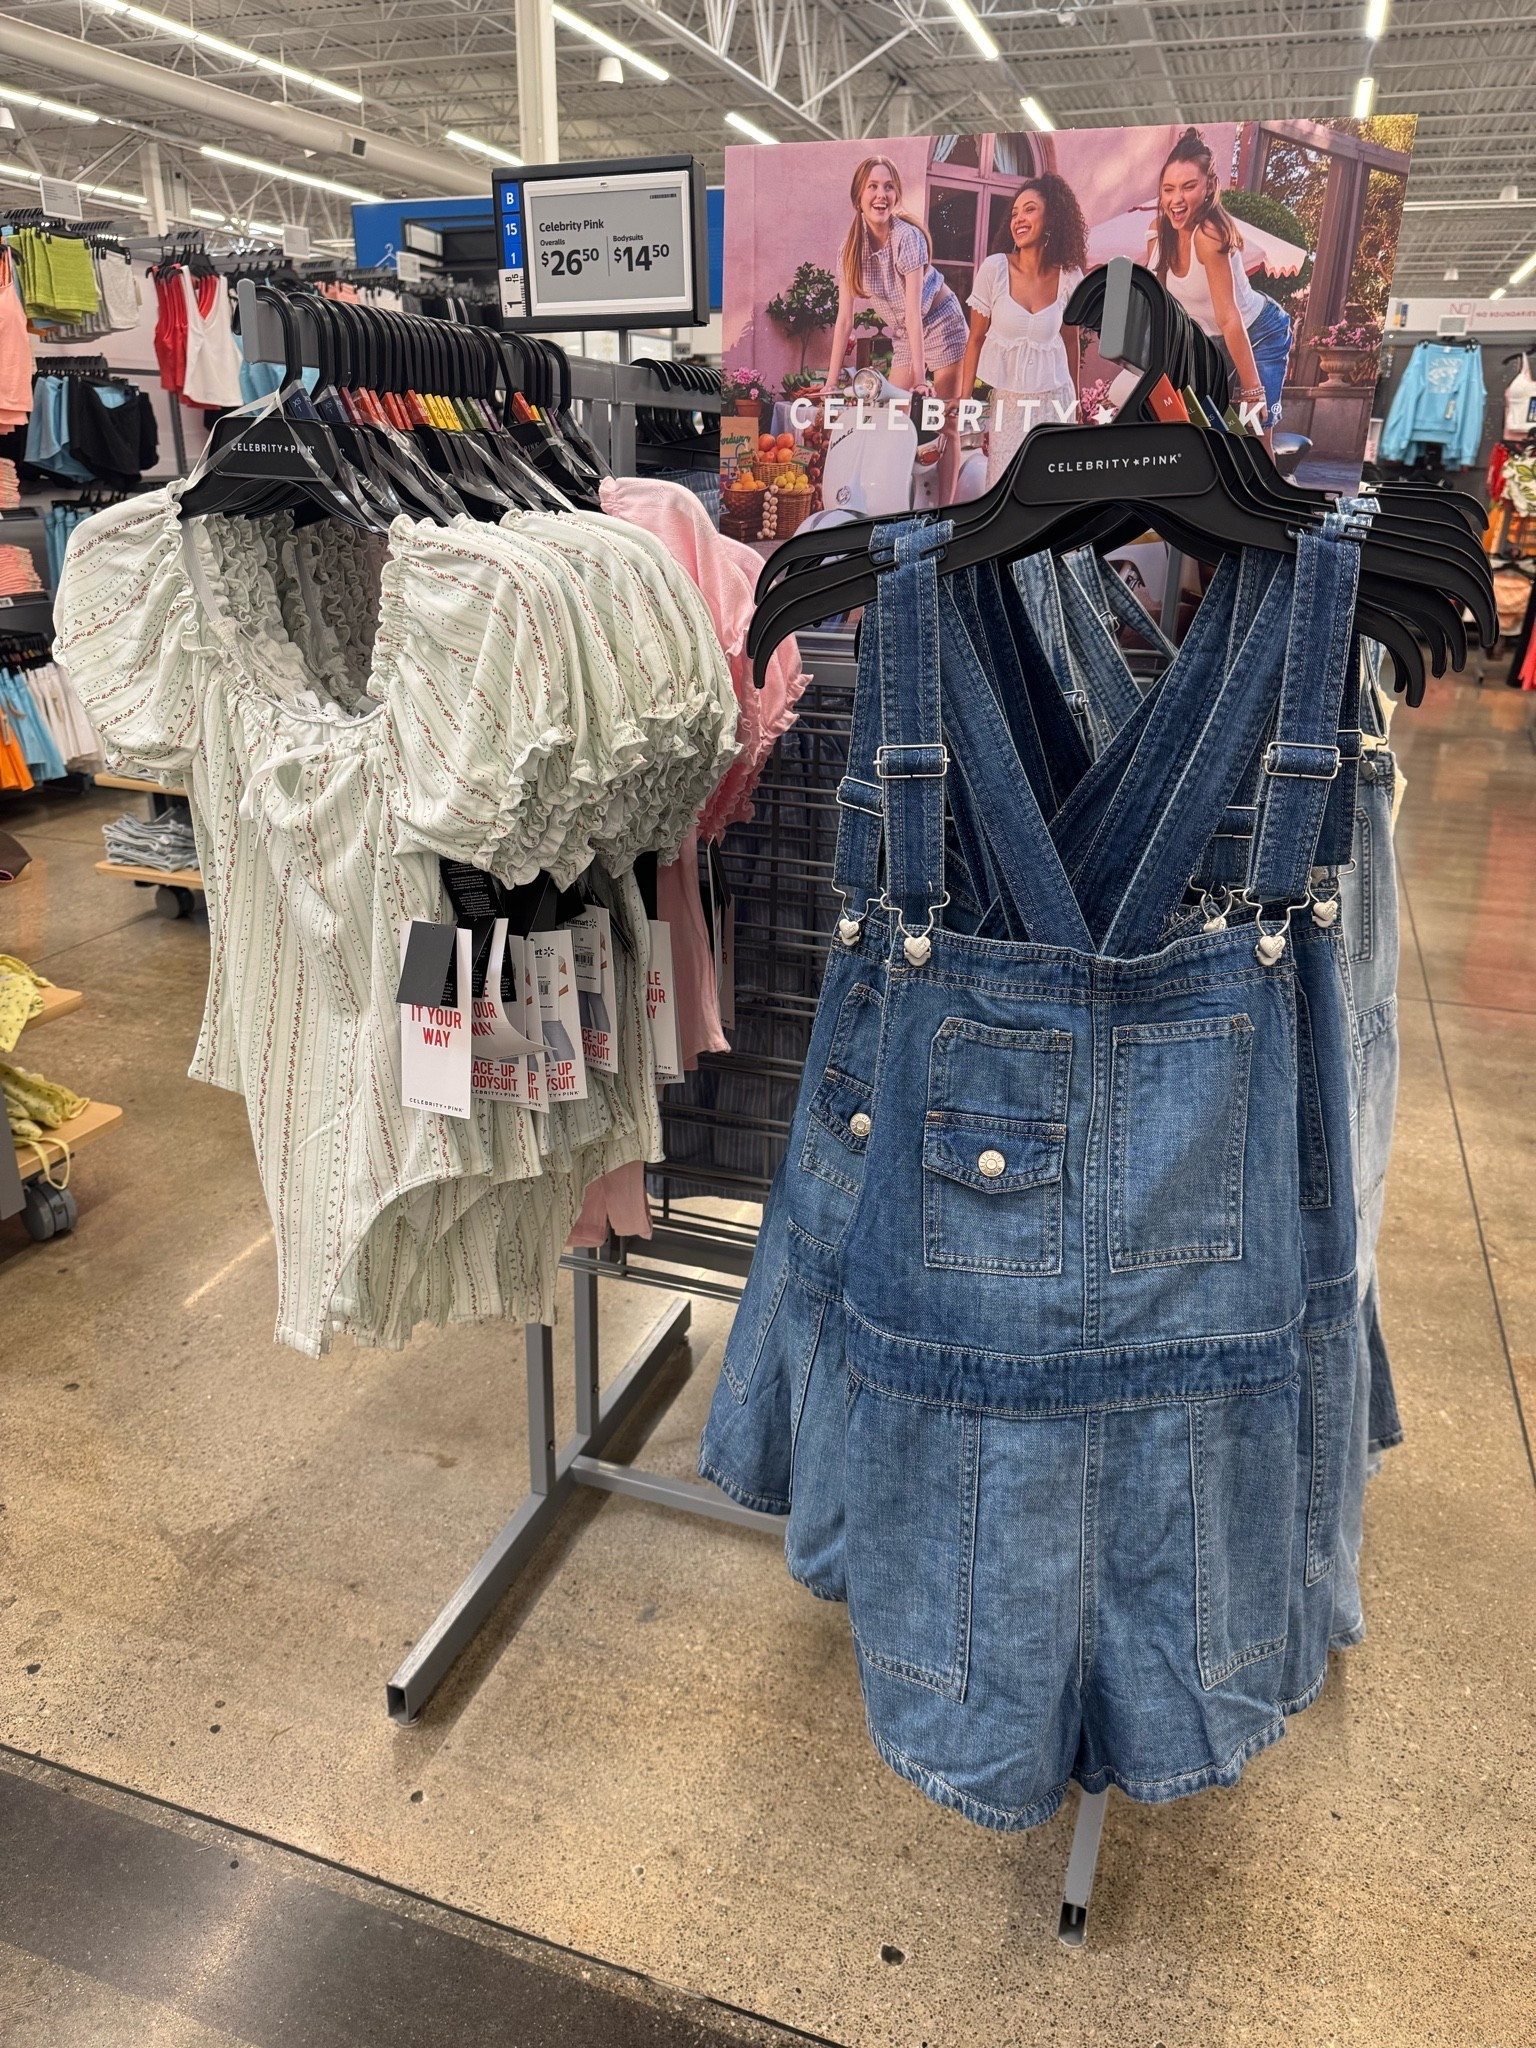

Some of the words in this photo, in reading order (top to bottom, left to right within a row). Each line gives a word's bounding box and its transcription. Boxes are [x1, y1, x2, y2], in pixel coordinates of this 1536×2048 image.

[507, 192, 514, 205] B
[505, 223, 517, 236] 15
[539, 221, 582, 232] Celebrity
[583, 219, 605, 230] Pink
[511, 252, 516, 265] 1
[1163, 396, 1173, 407] M
[790, 398, 1080, 432] CELEBRITY
[231, 442, 283, 453] CELEBRITY
[290, 444, 312, 454] PIK
[1048, 458, 1130, 474] CELEBRITY
[646, 988, 666, 1003] UR
[410, 1004, 423, 1022] IT
[427, 1007, 462, 1029] YOUR
[473, 1001, 498, 1018] OUR
[423, 1027, 451, 1048] WAY
[582, 1028, 608, 1046] CE-UP
[582, 1041, 610, 1060] DYSUIT
[472, 1060, 515, 1077] ACE-UP
[472, 1074, 518, 1091] ODYSUIT
[409, 1097, 443, 1109] CELEBRITY
